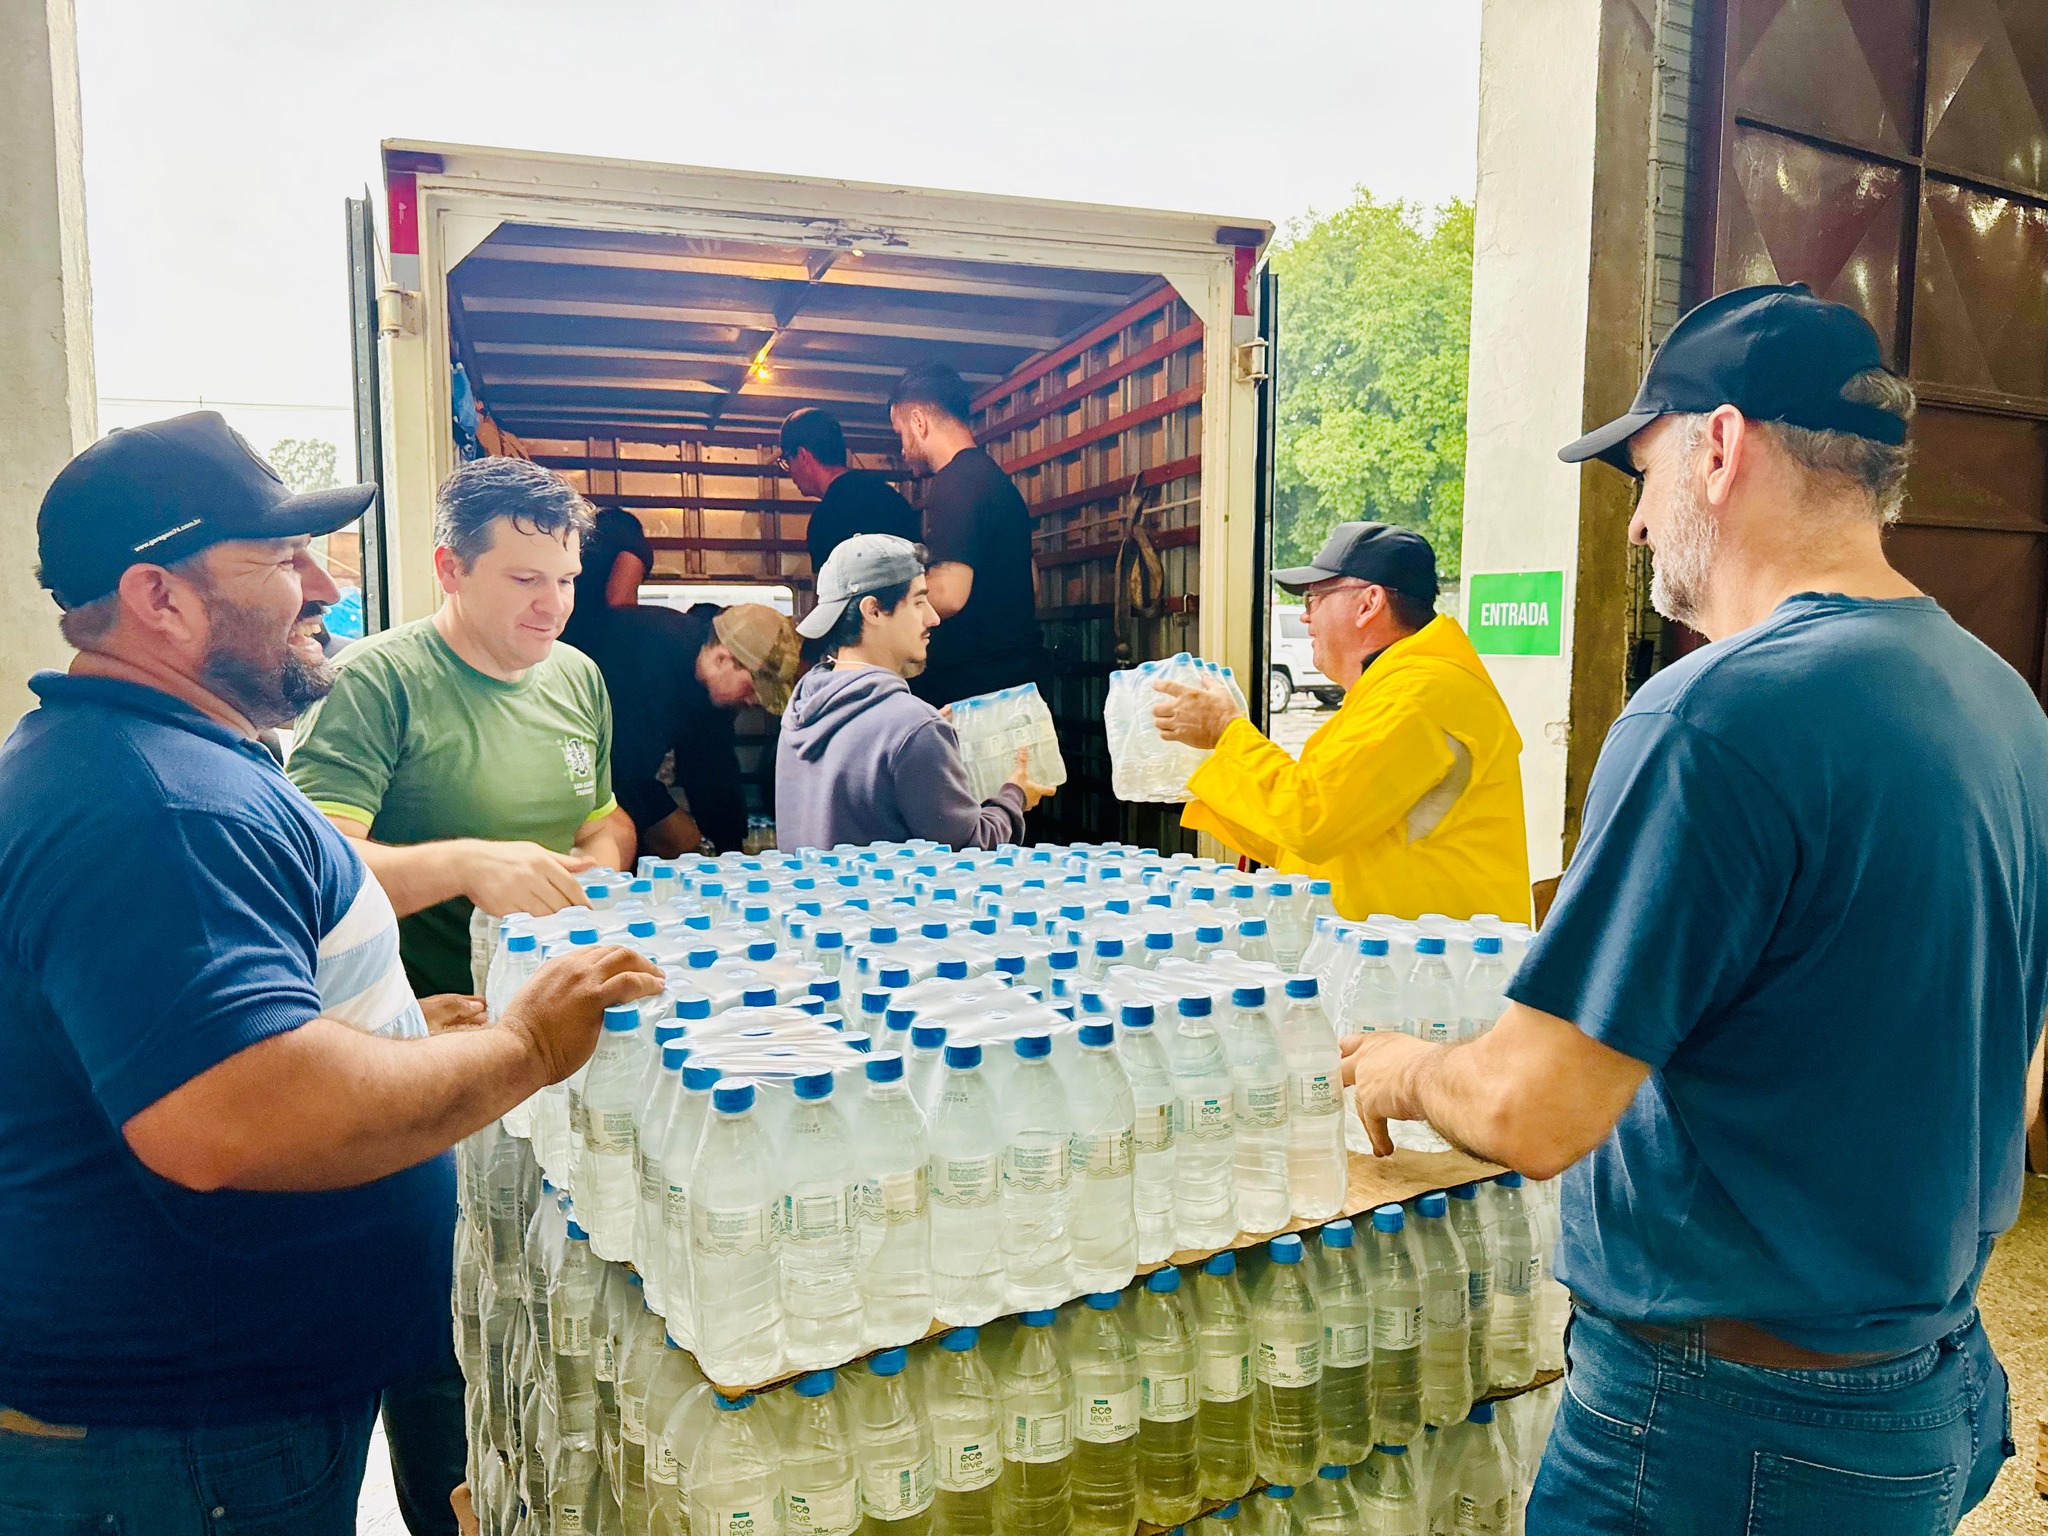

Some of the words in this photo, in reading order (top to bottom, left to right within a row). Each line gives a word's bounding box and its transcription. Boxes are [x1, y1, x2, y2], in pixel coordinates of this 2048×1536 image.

[1481, 602, 1549, 626] ENTRADA
[1311, 1082, 1330, 1091] eco
[1201, 1106, 1221, 1115] eco
[667, 1192, 687, 1203] eco
[1090, 1406, 1112, 1415] eco
[1090, 1413, 1112, 1423] leve
[960, 1451, 983, 1462] eco
[960, 1460, 983, 1471] leve
[789, 1502, 810, 1514] eco
[729, 1519, 754, 1530] eco
